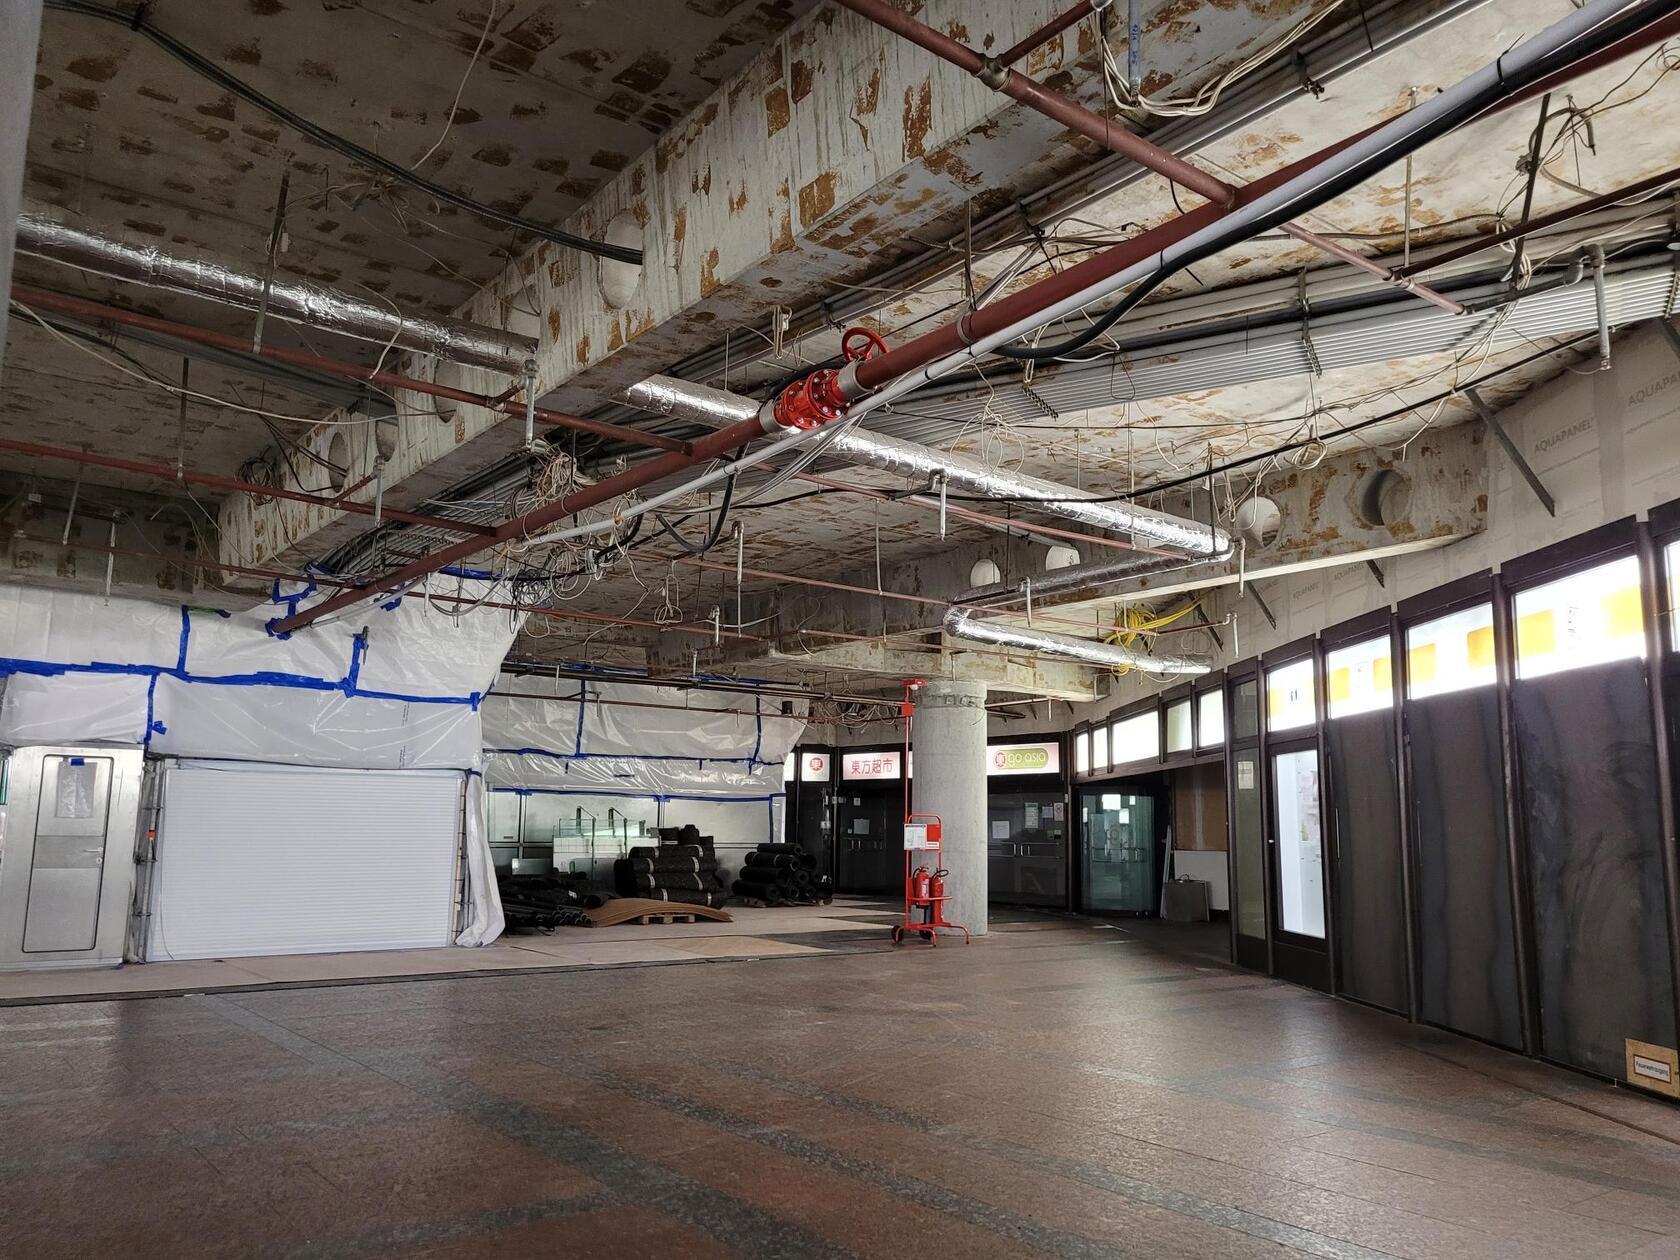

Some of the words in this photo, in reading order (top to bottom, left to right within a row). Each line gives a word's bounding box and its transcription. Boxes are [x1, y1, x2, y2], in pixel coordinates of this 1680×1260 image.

[1628, 371, 1680, 407] AQUAPA
[1534, 420, 1593, 454] AQUAPANEL
[850, 758, 893, 775] 東方超市
